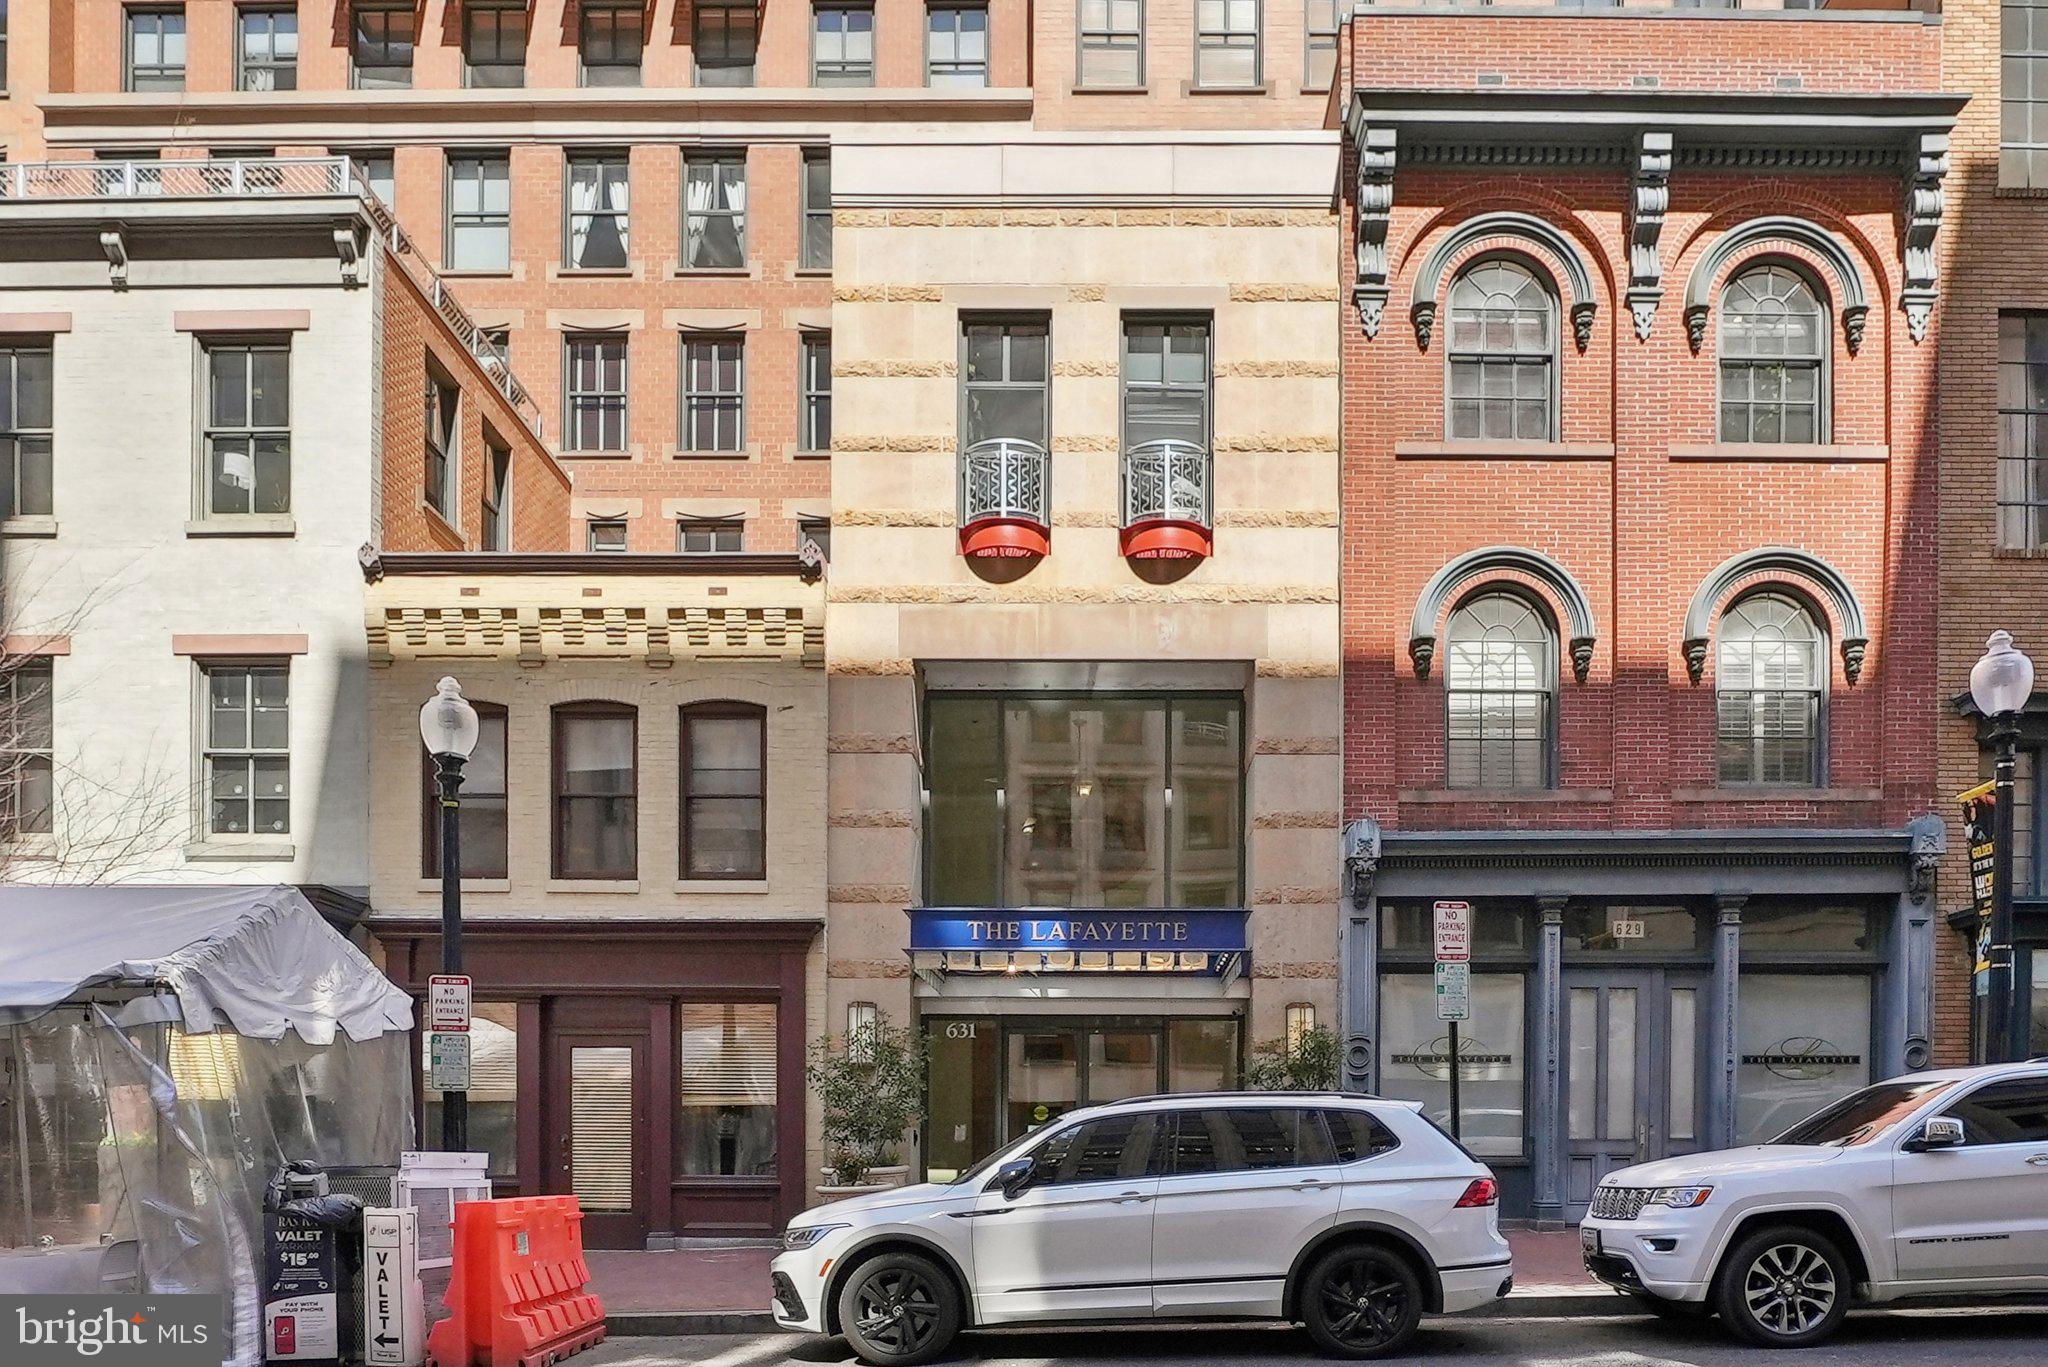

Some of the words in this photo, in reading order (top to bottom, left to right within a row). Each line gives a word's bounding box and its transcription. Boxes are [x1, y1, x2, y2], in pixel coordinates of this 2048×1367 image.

[1445, 911, 1458, 920] NO
[967, 920, 1020, 941] THE
[1030, 920, 1188, 941] LAFAYETTE
[1437, 922, 1466, 931] PARKING
[1616, 923, 1641, 935] 629
[1438, 934, 1466, 942] ENTRANCE
[435, 1007, 465, 1015] ENTRANCE
[945, 1022, 977, 1039] 631
[274, 1231, 323, 1242] VALET
[376, 1252, 389, 1330] VALET
